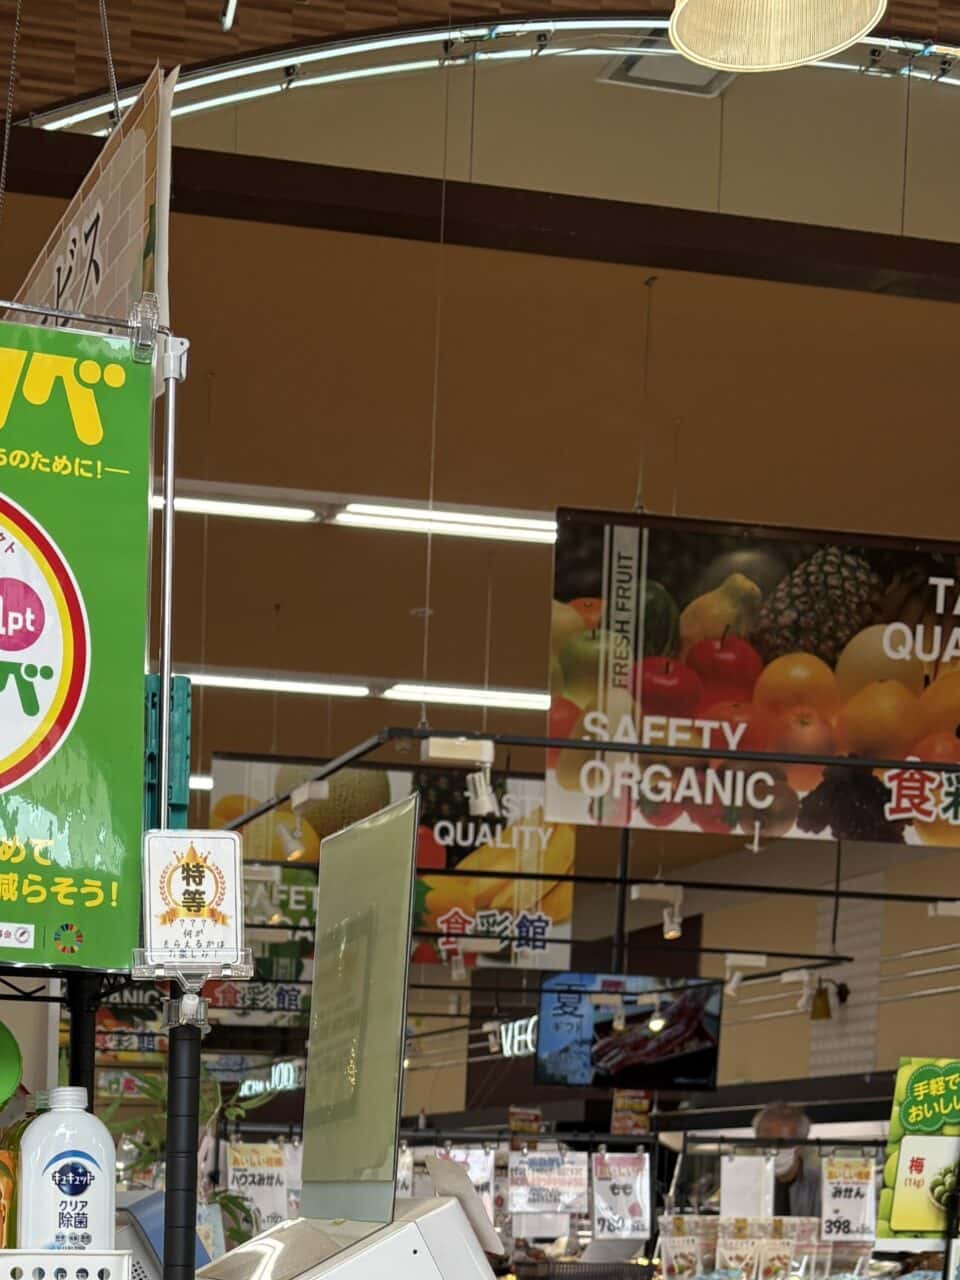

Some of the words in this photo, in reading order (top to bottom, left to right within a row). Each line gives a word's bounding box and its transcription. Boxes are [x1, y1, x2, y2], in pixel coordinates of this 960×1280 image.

[614, 551, 635, 613] FRUIT
[612, 619, 632, 690] FRESH
[580, 759, 775, 810] ORGANIC
[433, 820, 553, 849] QUALITY
[908, 1156, 927, 1175] 梅
[52, 1172, 95, 1186] キュキュット
[231, 1171, 283, 1187] ハウスみかん
[59, 1200, 88, 1211] クリア
[58, 1212, 88, 1229] 除菌
[824, 1219, 851, 1234] 398
